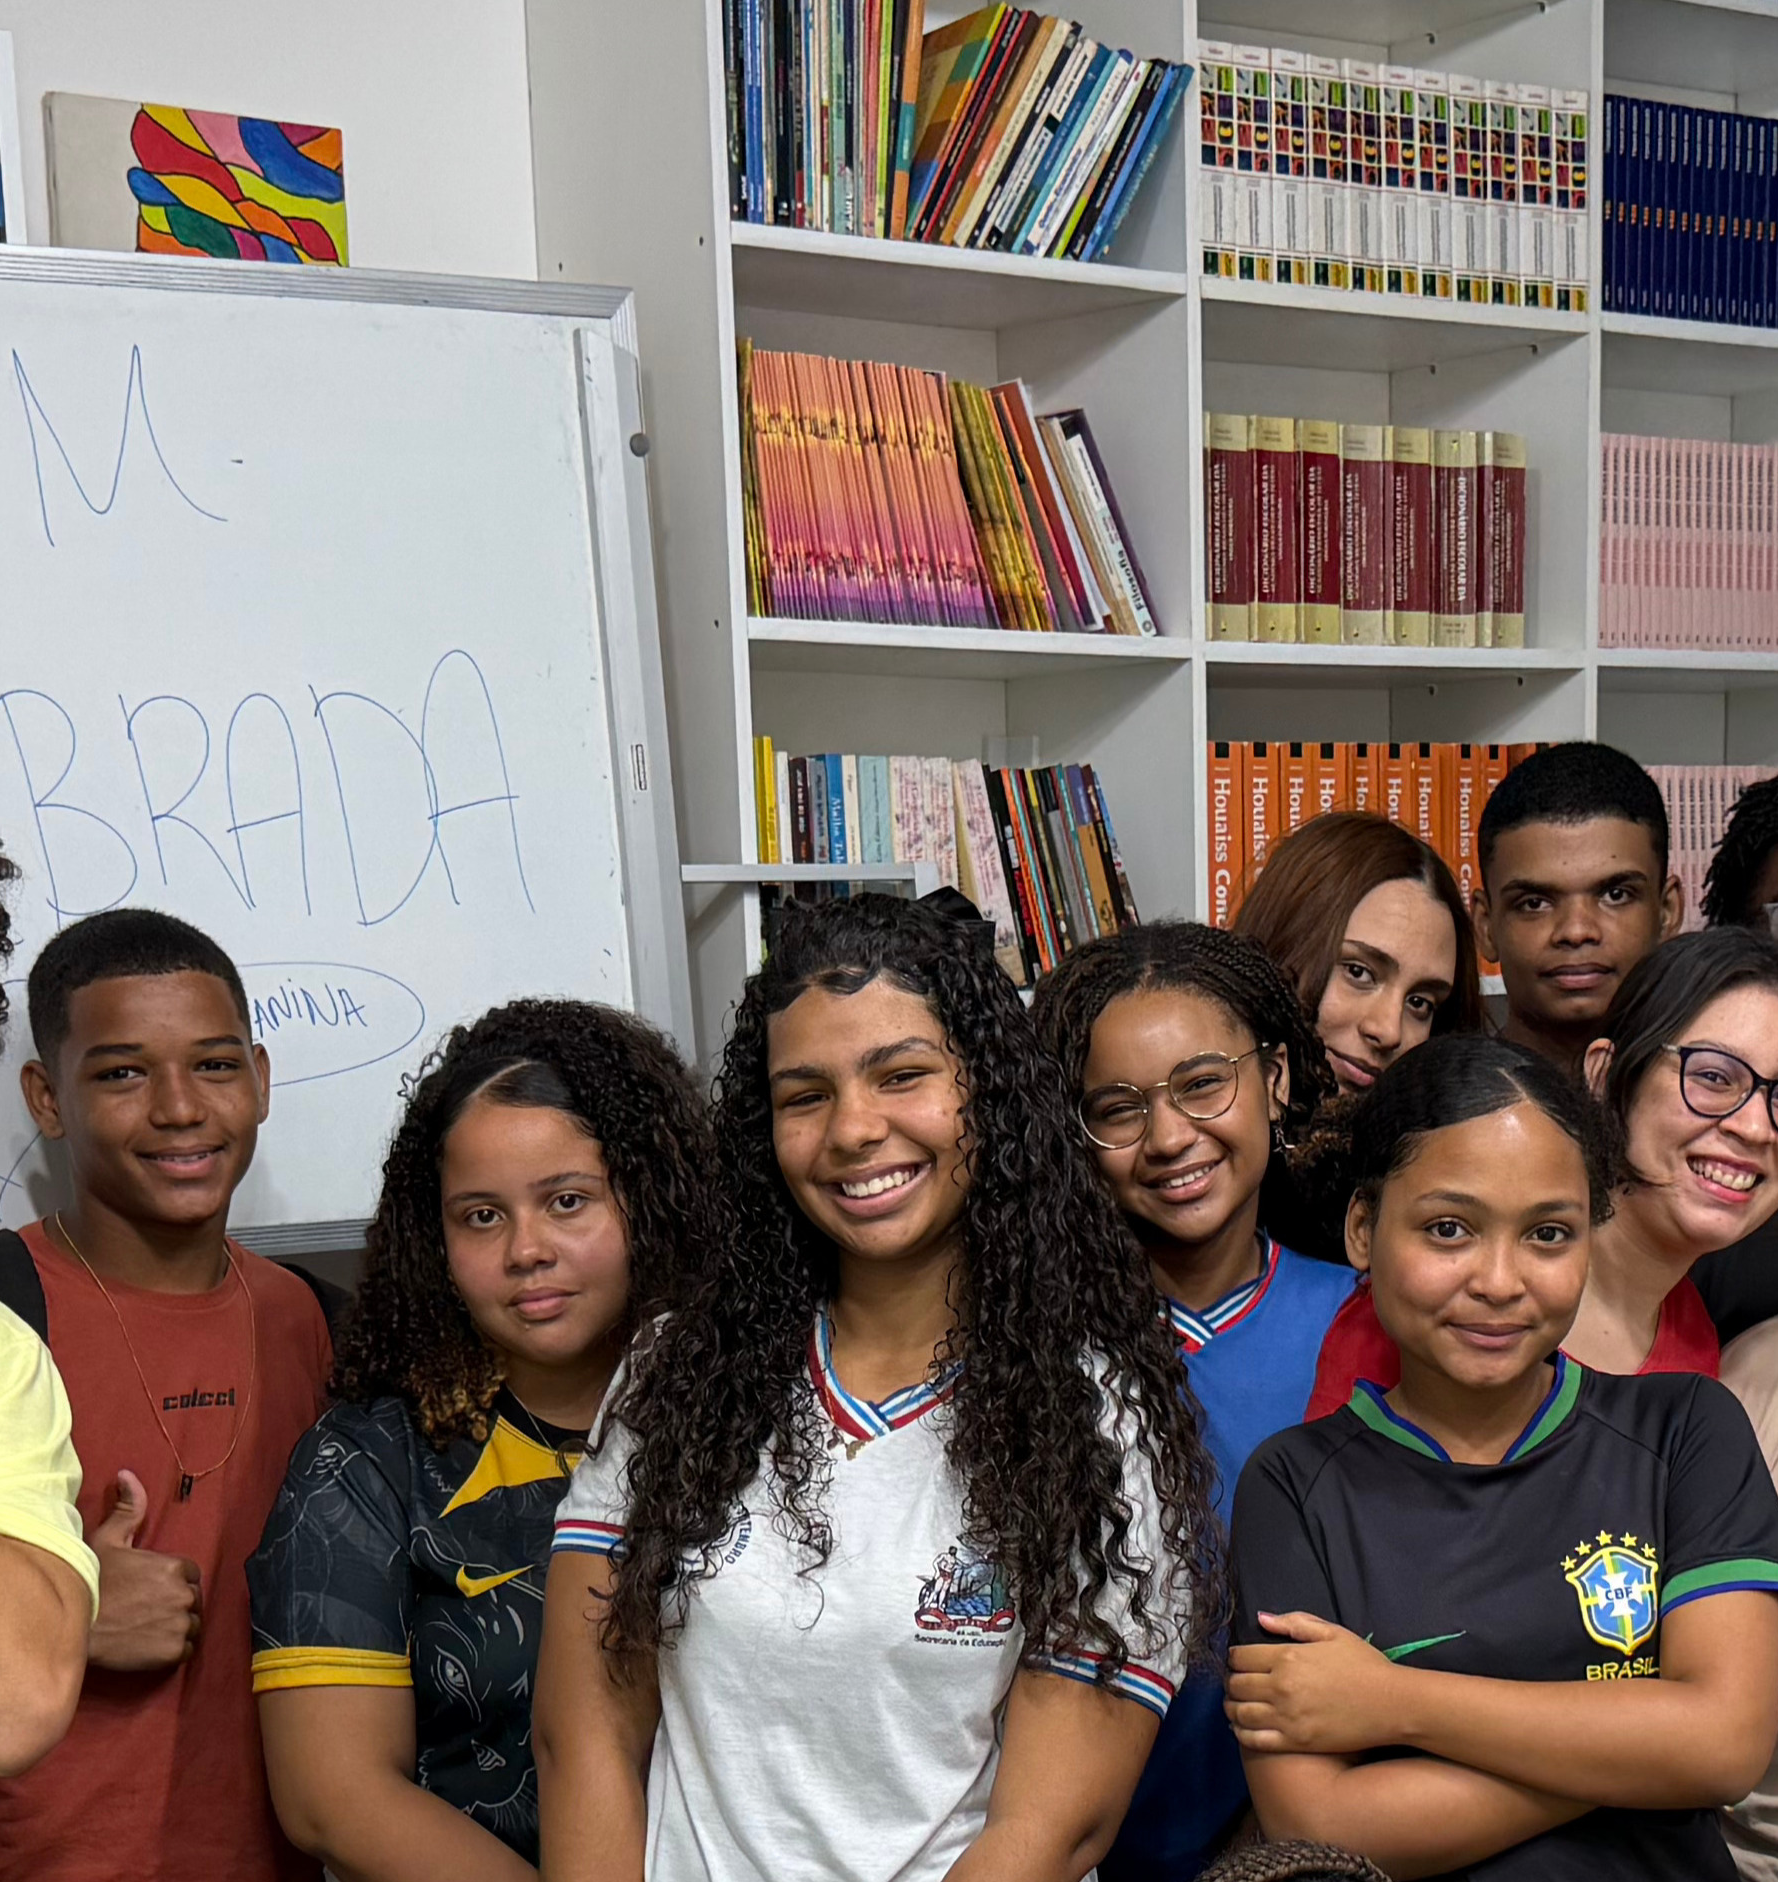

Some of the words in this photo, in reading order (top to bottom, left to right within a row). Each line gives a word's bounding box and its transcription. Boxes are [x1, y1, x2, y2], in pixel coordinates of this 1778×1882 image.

[1118, 550, 1142, 612] Filosofia
[1213, 778, 1231, 863] Houaiss
[1252, 777, 1268, 862] Houaiss
[1459, 777, 1475, 857] Houaiss
[1604, 1586, 1634, 1601] CBF
[1587, 1657, 1661, 1682] BRASIL
